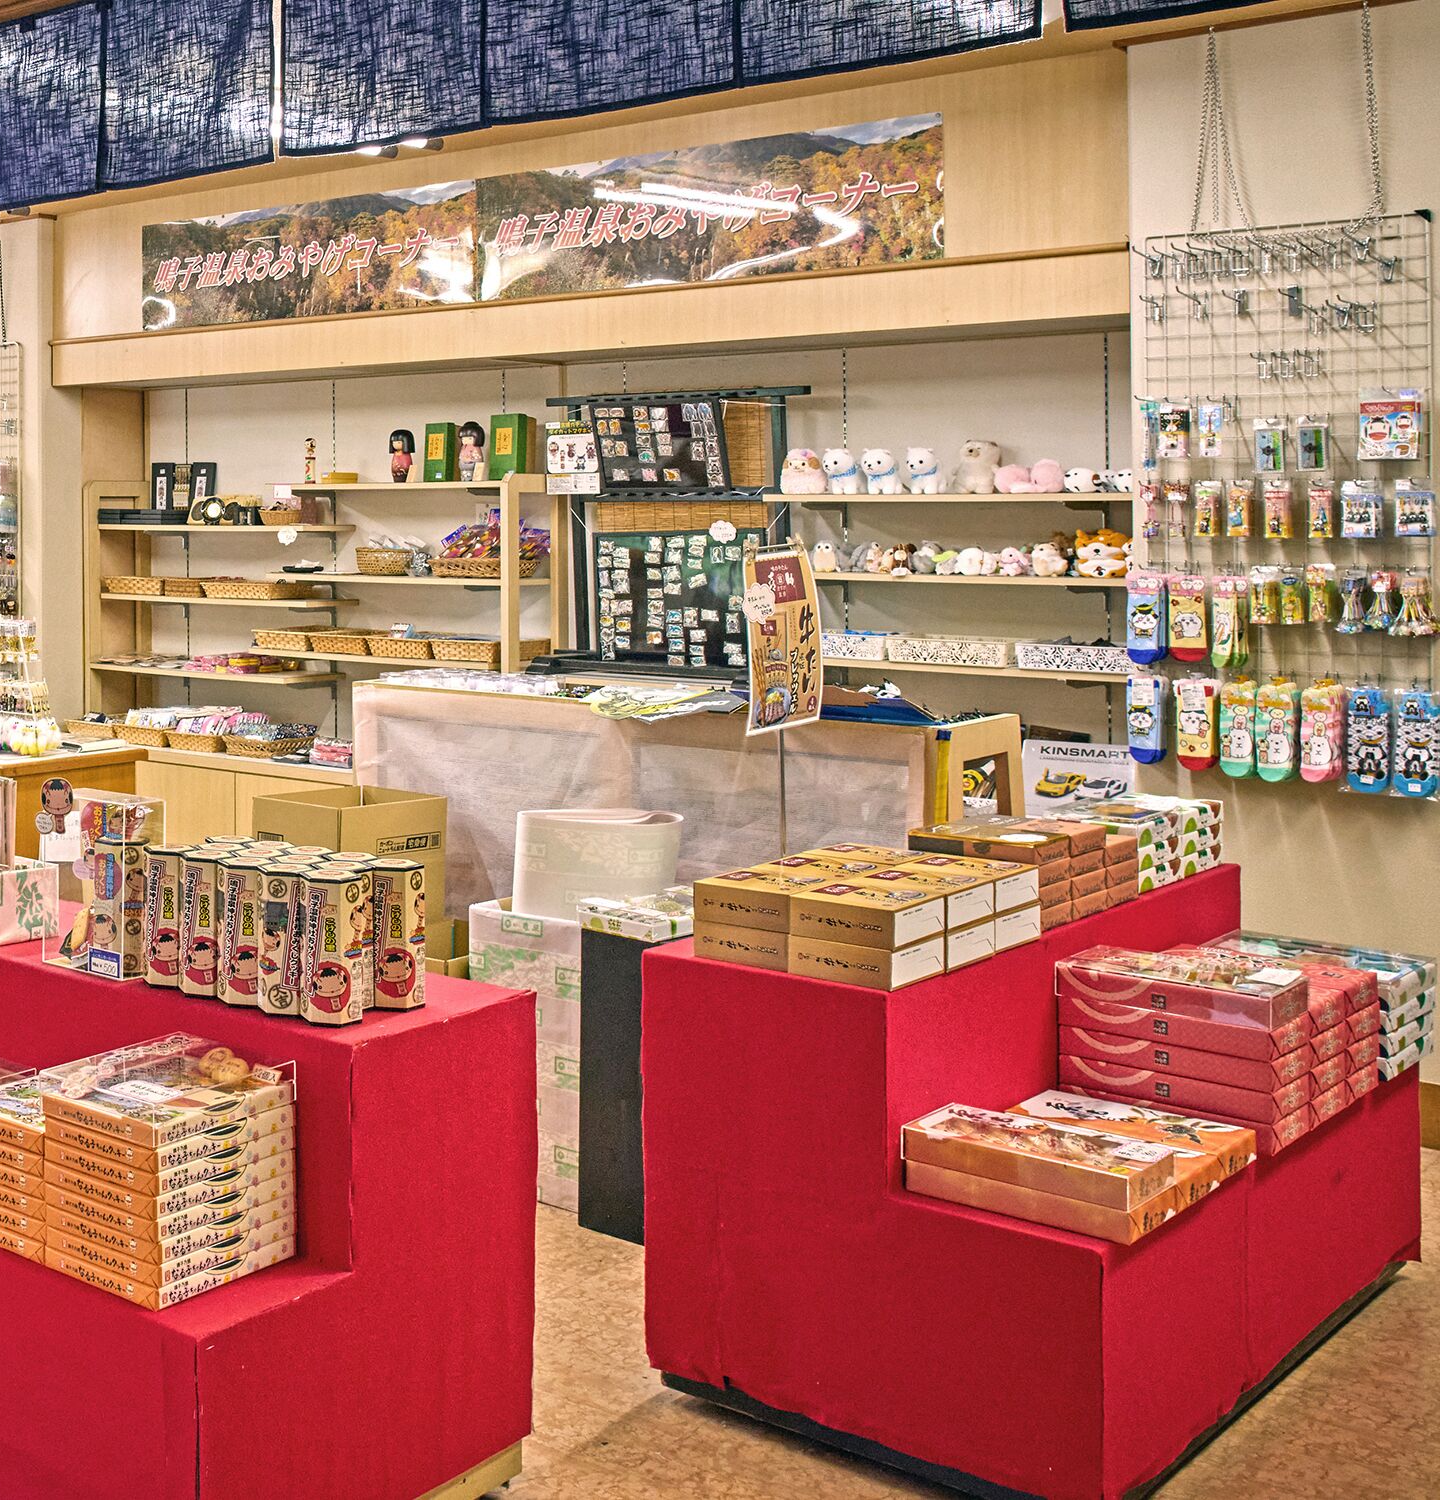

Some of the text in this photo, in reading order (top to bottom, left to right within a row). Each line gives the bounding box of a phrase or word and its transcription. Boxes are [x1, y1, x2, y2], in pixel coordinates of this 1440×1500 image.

[496, 170, 919, 254] 鳴子温泉おみやげコーナー
[154, 227, 461, 292] 鳴子温泉おみやげコーナー
[800, 603, 816, 694] 牛たん
[1040, 745, 1131, 759] KINSMART
[163, 886, 174, 920] こけしの里
[198, 894, 210, 928] こけしの里
[242, 902, 254, 936] こけしの里
[390, 904, 402, 939] こけしの里
[324, 917, 337, 952] こけしの里
[167, 1118, 219, 1141] なる子ちゃんクッキー
[168, 1143, 221, 1165] なる子ちゃんクッキー
[169, 1166, 222, 1189] なる子ちゃんクッキー
[166, 1189, 222, 1213] なる子ちゃんクッキー
[169, 1211, 223, 1236] なる子ちゃんクッキー
[172, 1233, 224, 1258] なる子ちゃんクッキー
[171, 1256, 223, 1281] なる子ちゃんクッキー
[169, 1278, 223, 1303] なる子ちゃんクッキー
